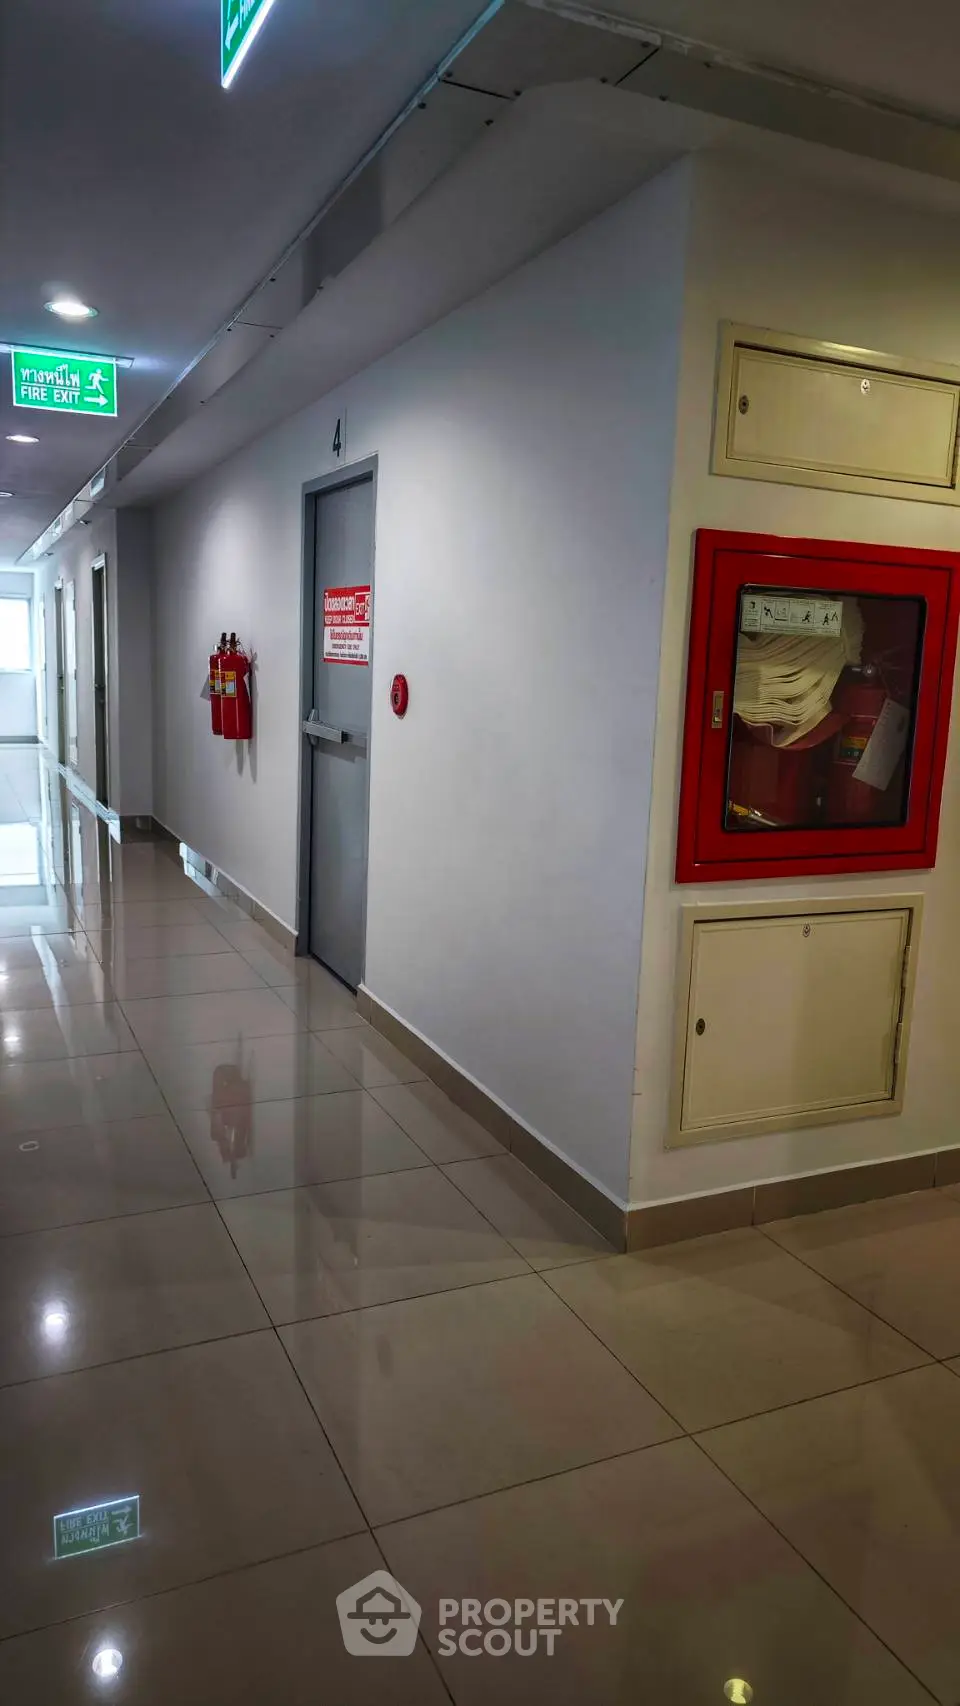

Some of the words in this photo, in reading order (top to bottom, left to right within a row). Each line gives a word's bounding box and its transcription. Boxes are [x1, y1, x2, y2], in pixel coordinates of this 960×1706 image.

[20, 363, 80, 387] ทางหนีไฟ
[20, 386, 48, 401] FIRE
[54, 390, 80, 404] EXIT
[333, 418, 342, 457] 4
